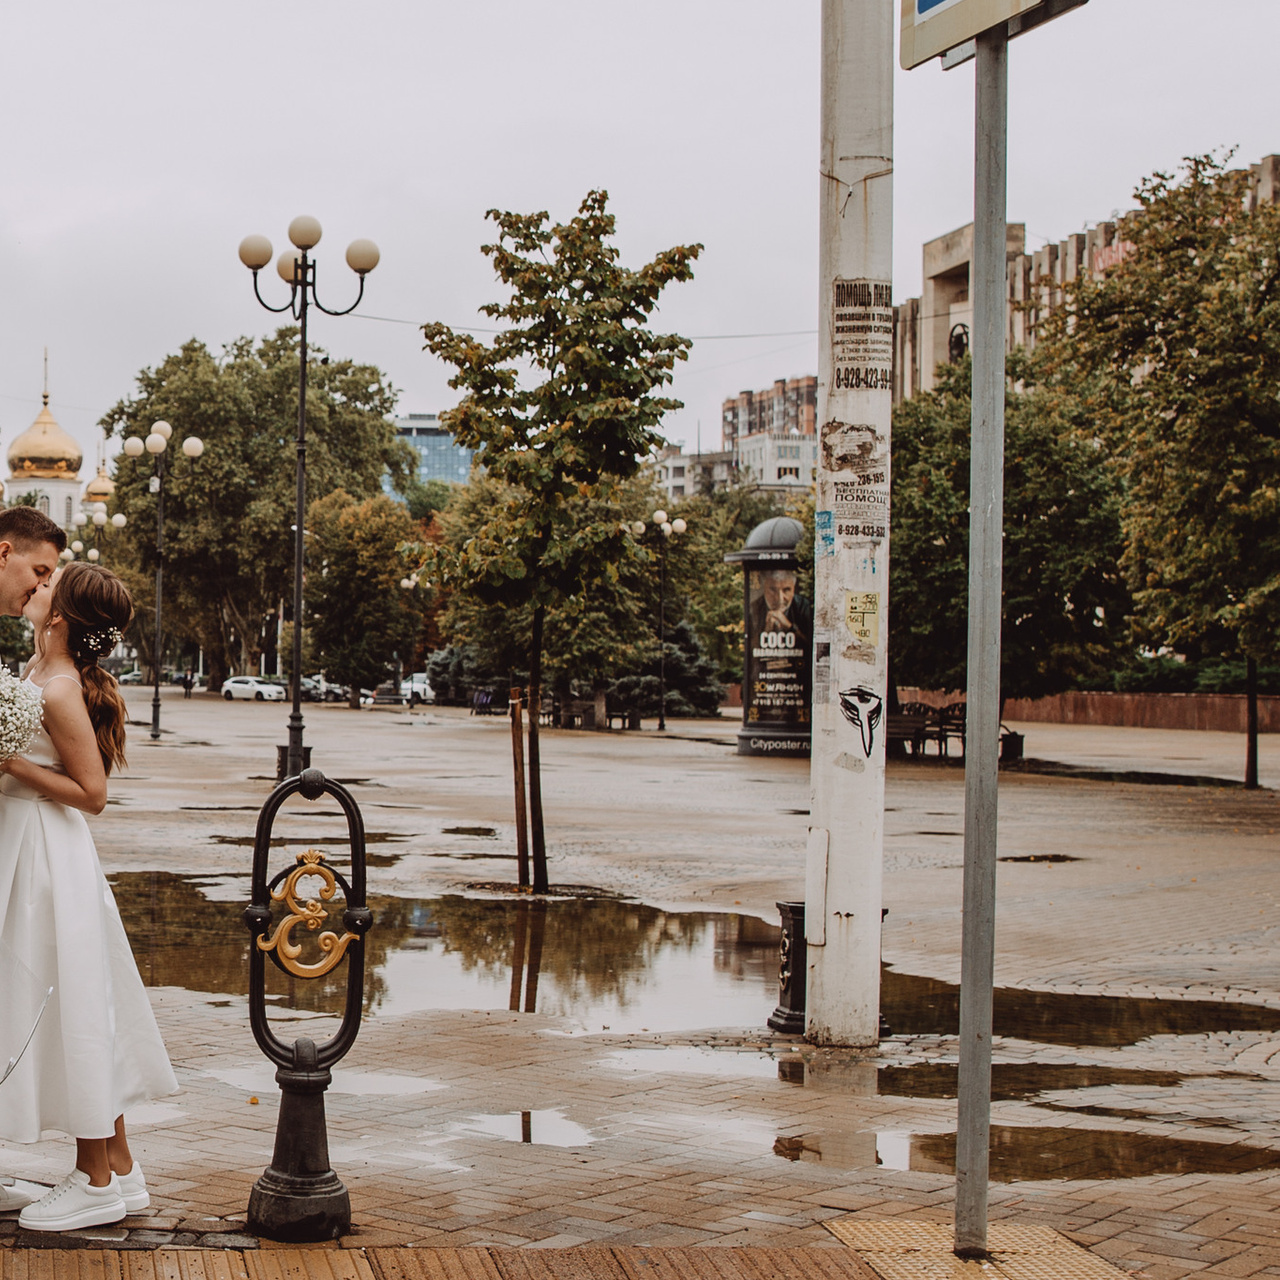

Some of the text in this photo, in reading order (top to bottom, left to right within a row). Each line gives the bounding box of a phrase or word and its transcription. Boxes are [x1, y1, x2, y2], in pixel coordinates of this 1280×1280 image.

[836, 283, 872, 310] ПОМОЩЬ
[835, 494, 886, 505] ПОМОЩ
[760, 631, 795, 648] СОСО
[750, 738, 811, 751] Cityposter.ru
